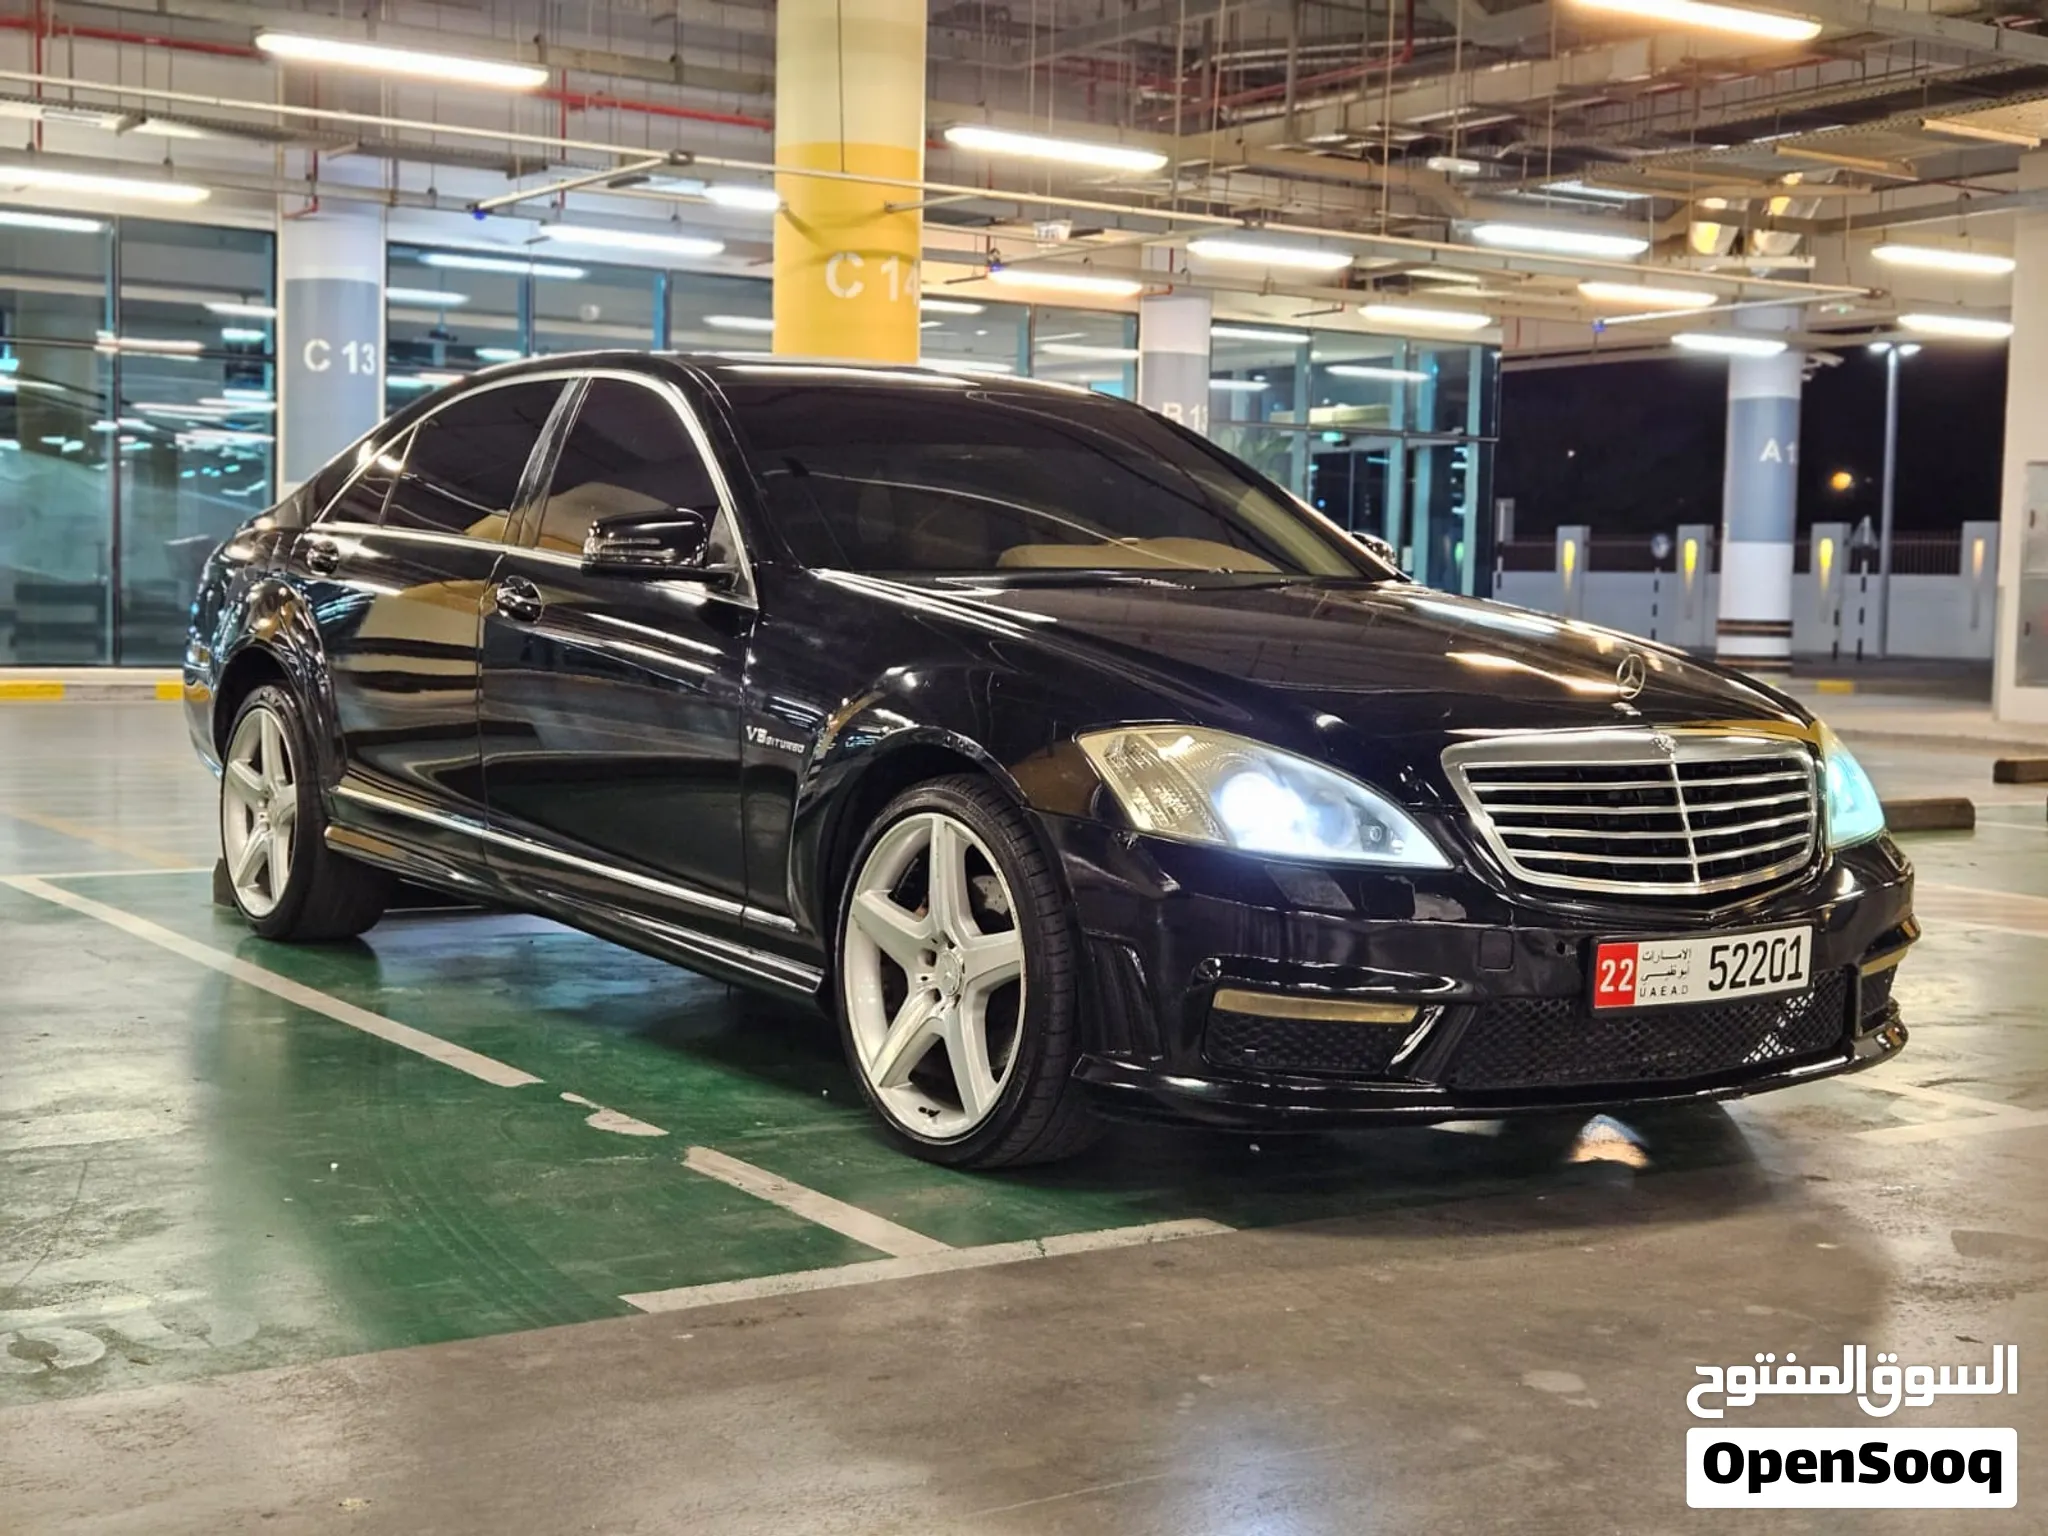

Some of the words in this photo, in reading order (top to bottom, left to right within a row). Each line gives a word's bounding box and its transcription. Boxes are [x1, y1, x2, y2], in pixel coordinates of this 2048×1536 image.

[825, 252, 865, 299] C
[304, 338, 331, 372] C
[341, 340, 376, 375] 13
[1760, 438, 1782, 463] A
[1600, 958, 1634, 992] 22
[1708, 935, 1803, 992] 52201
